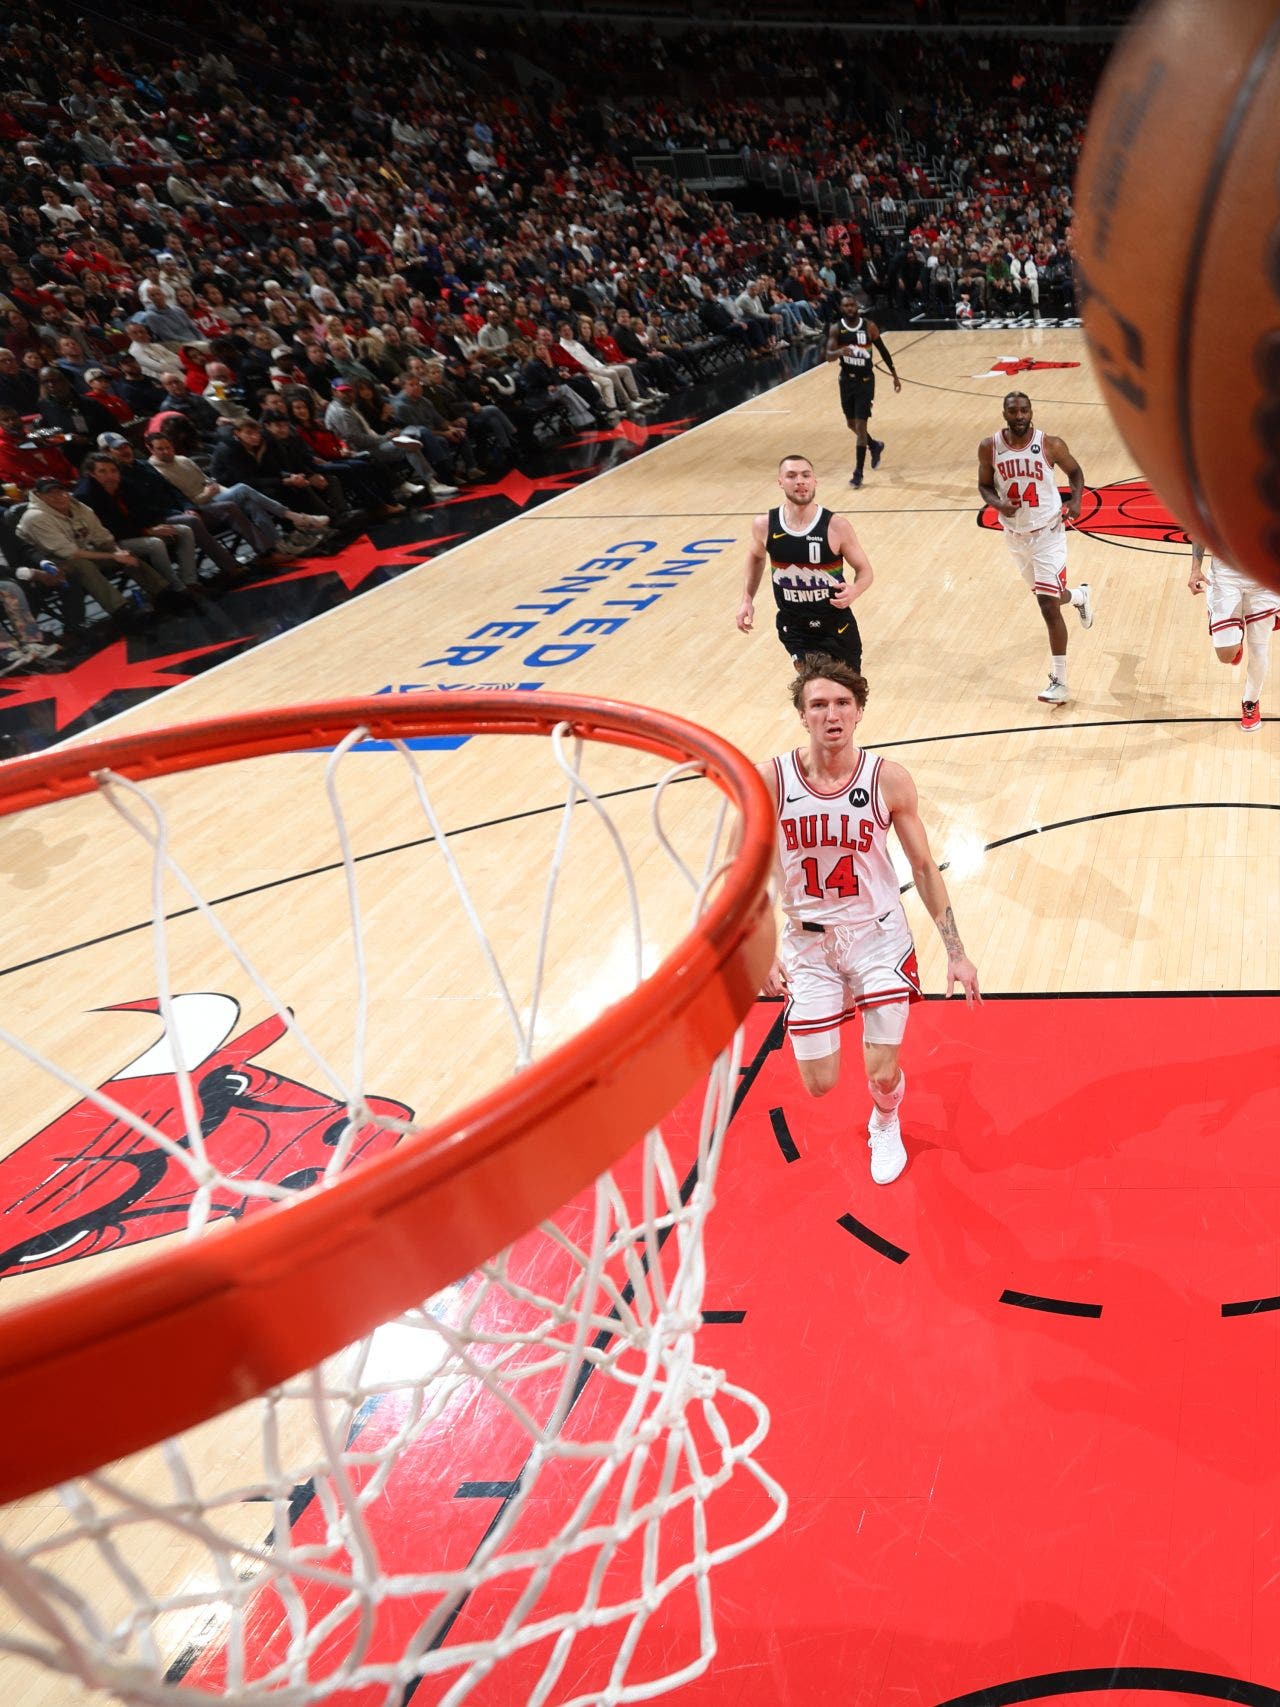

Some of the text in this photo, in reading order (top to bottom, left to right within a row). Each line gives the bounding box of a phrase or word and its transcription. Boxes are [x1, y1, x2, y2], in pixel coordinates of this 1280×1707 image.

[857, 332, 866, 344] 10
[997, 458, 1044, 481] BULLS
[1007, 482, 1040, 508] 44
[809, 542, 821, 564] 0
[418, 540, 658, 668] CENTER
[523, 538, 737, 667] UNITED
[783, 588, 830, 602] DENVER
[781, 814, 874, 852] BULLS
[801, 854, 859, 899] 14
